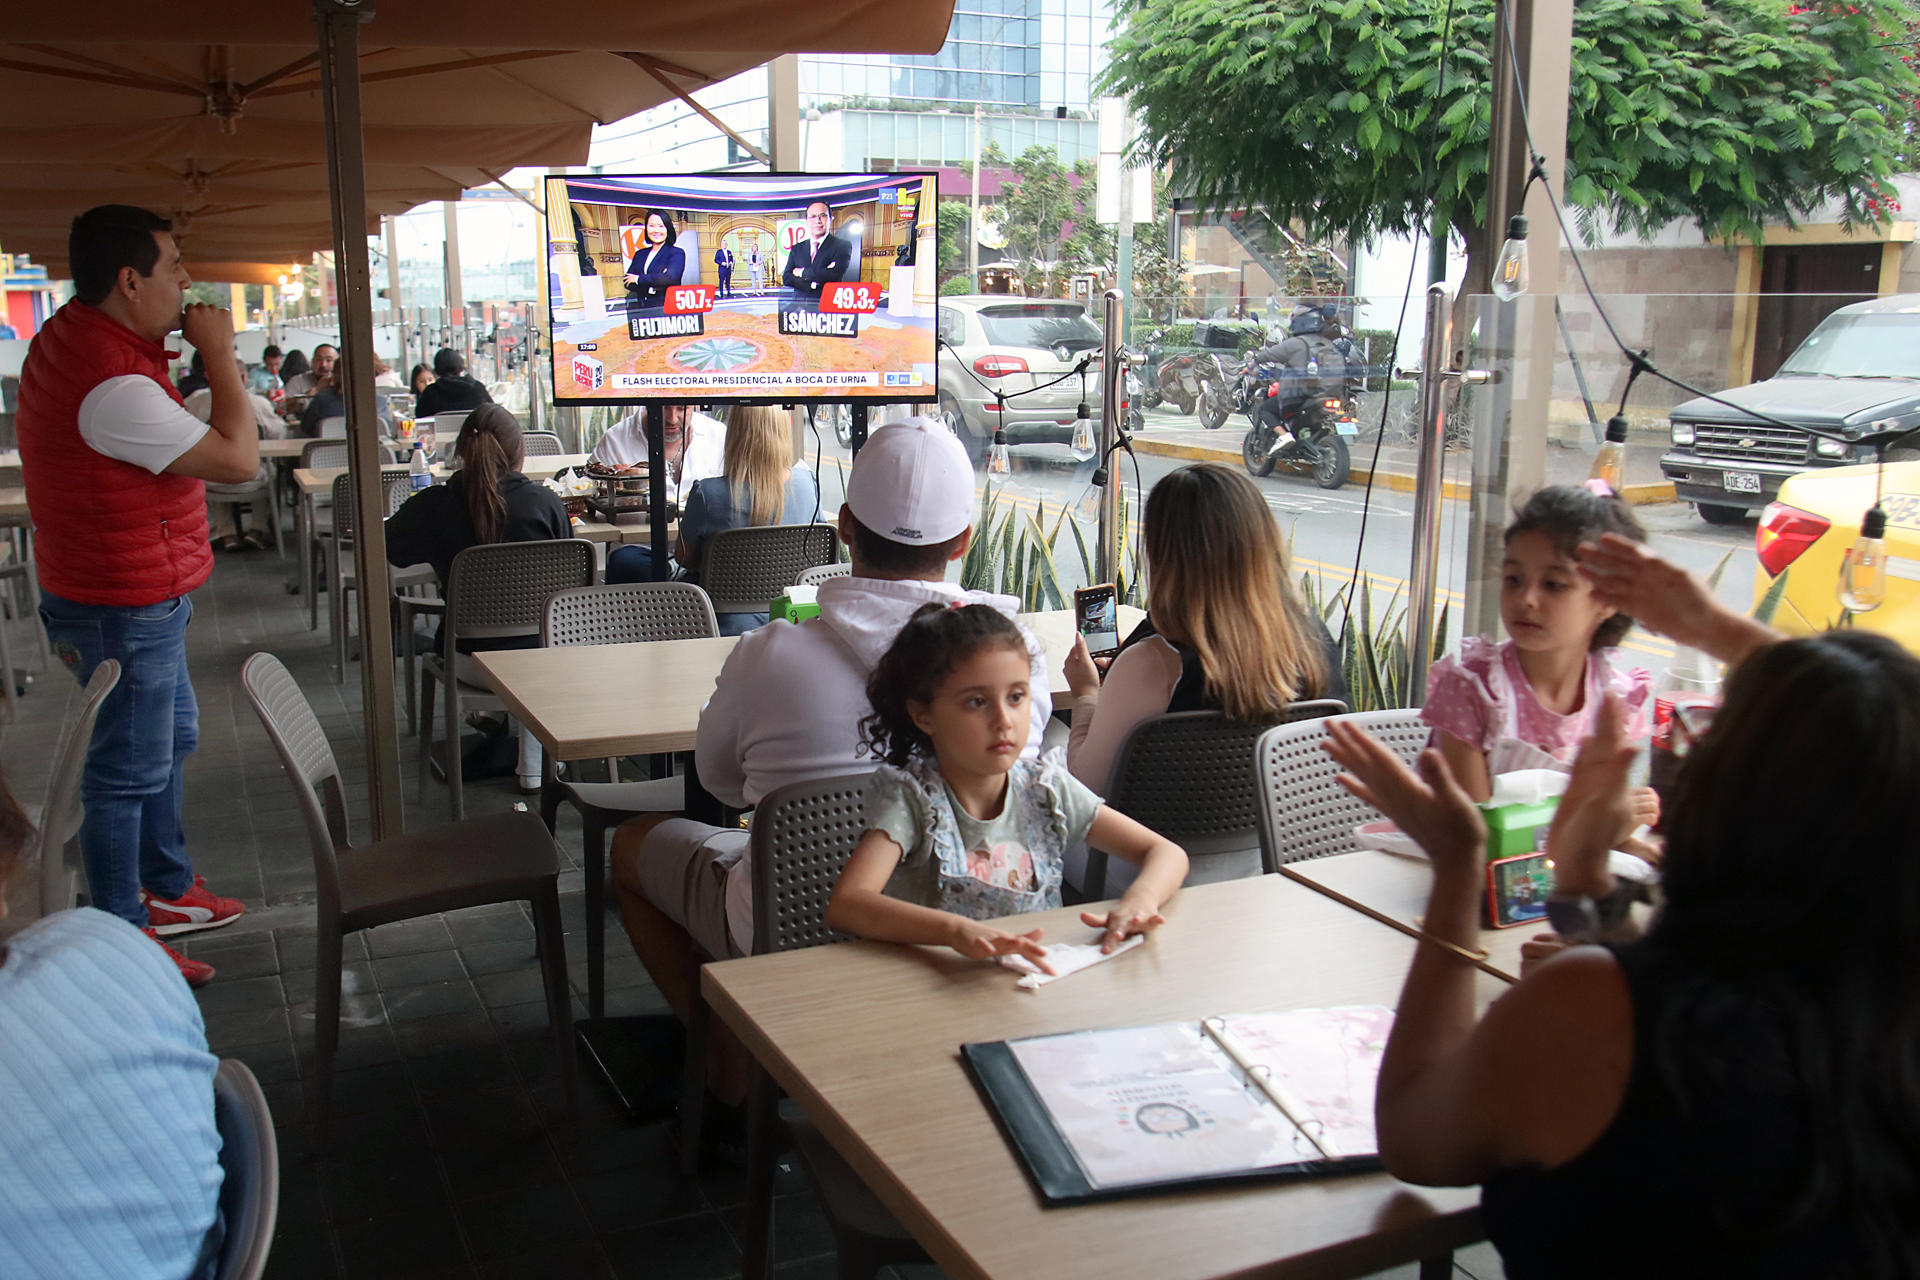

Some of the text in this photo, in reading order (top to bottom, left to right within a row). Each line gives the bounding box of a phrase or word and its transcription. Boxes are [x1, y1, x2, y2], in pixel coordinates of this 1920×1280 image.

[675, 289, 713, 310] 50.7%
[832, 287, 876, 310] 49.3%
[638, 314, 700, 337] FUJIMORI
[788, 309, 855, 335] SÁNCHEZ
[622, 375, 867, 386] FLASH ELECTORAL PRESIDENCIAL A BOCA DE URNA
[1726, 475, 1759, 490] ADE-254
